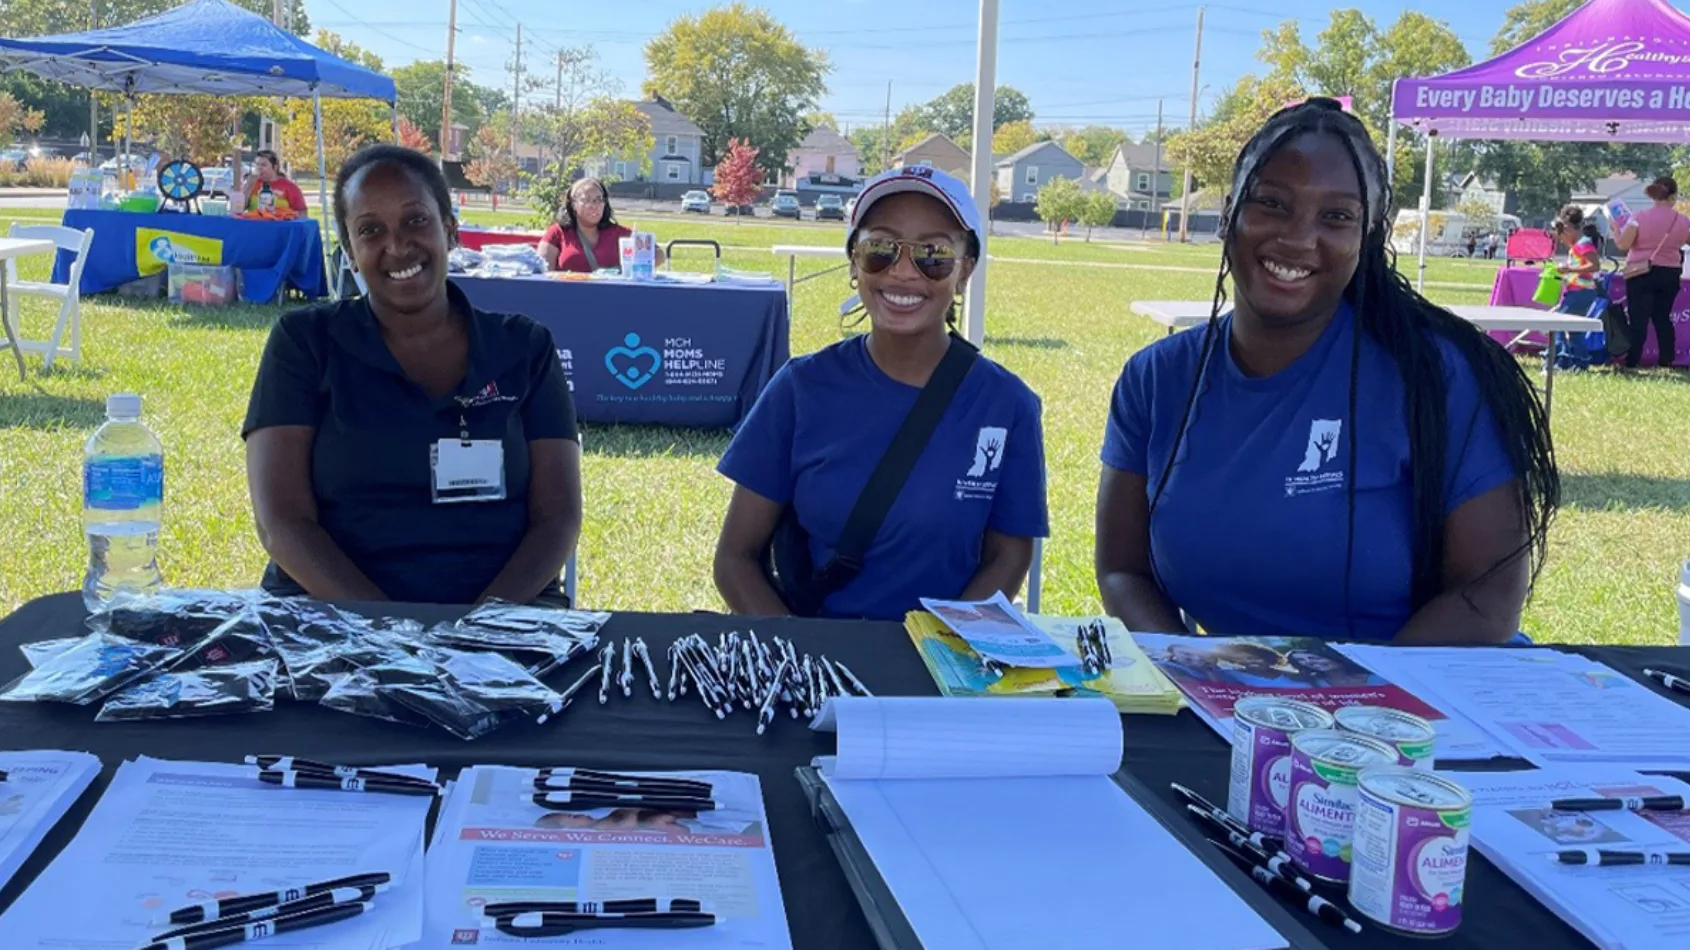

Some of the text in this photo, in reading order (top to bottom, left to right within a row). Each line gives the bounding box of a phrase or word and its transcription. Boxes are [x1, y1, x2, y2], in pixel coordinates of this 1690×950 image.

[1416, 86, 1476, 111] Every
[1479, 84, 1535, 112] Baby
[1538, 85, 1645, 108] Deserves
[1649, 89, 1663, 109] a
[665, 338, 691, 347] MCH
[664, 349, 703, 359] MOMS
[664, 360, 725, 369] HELPLINE
